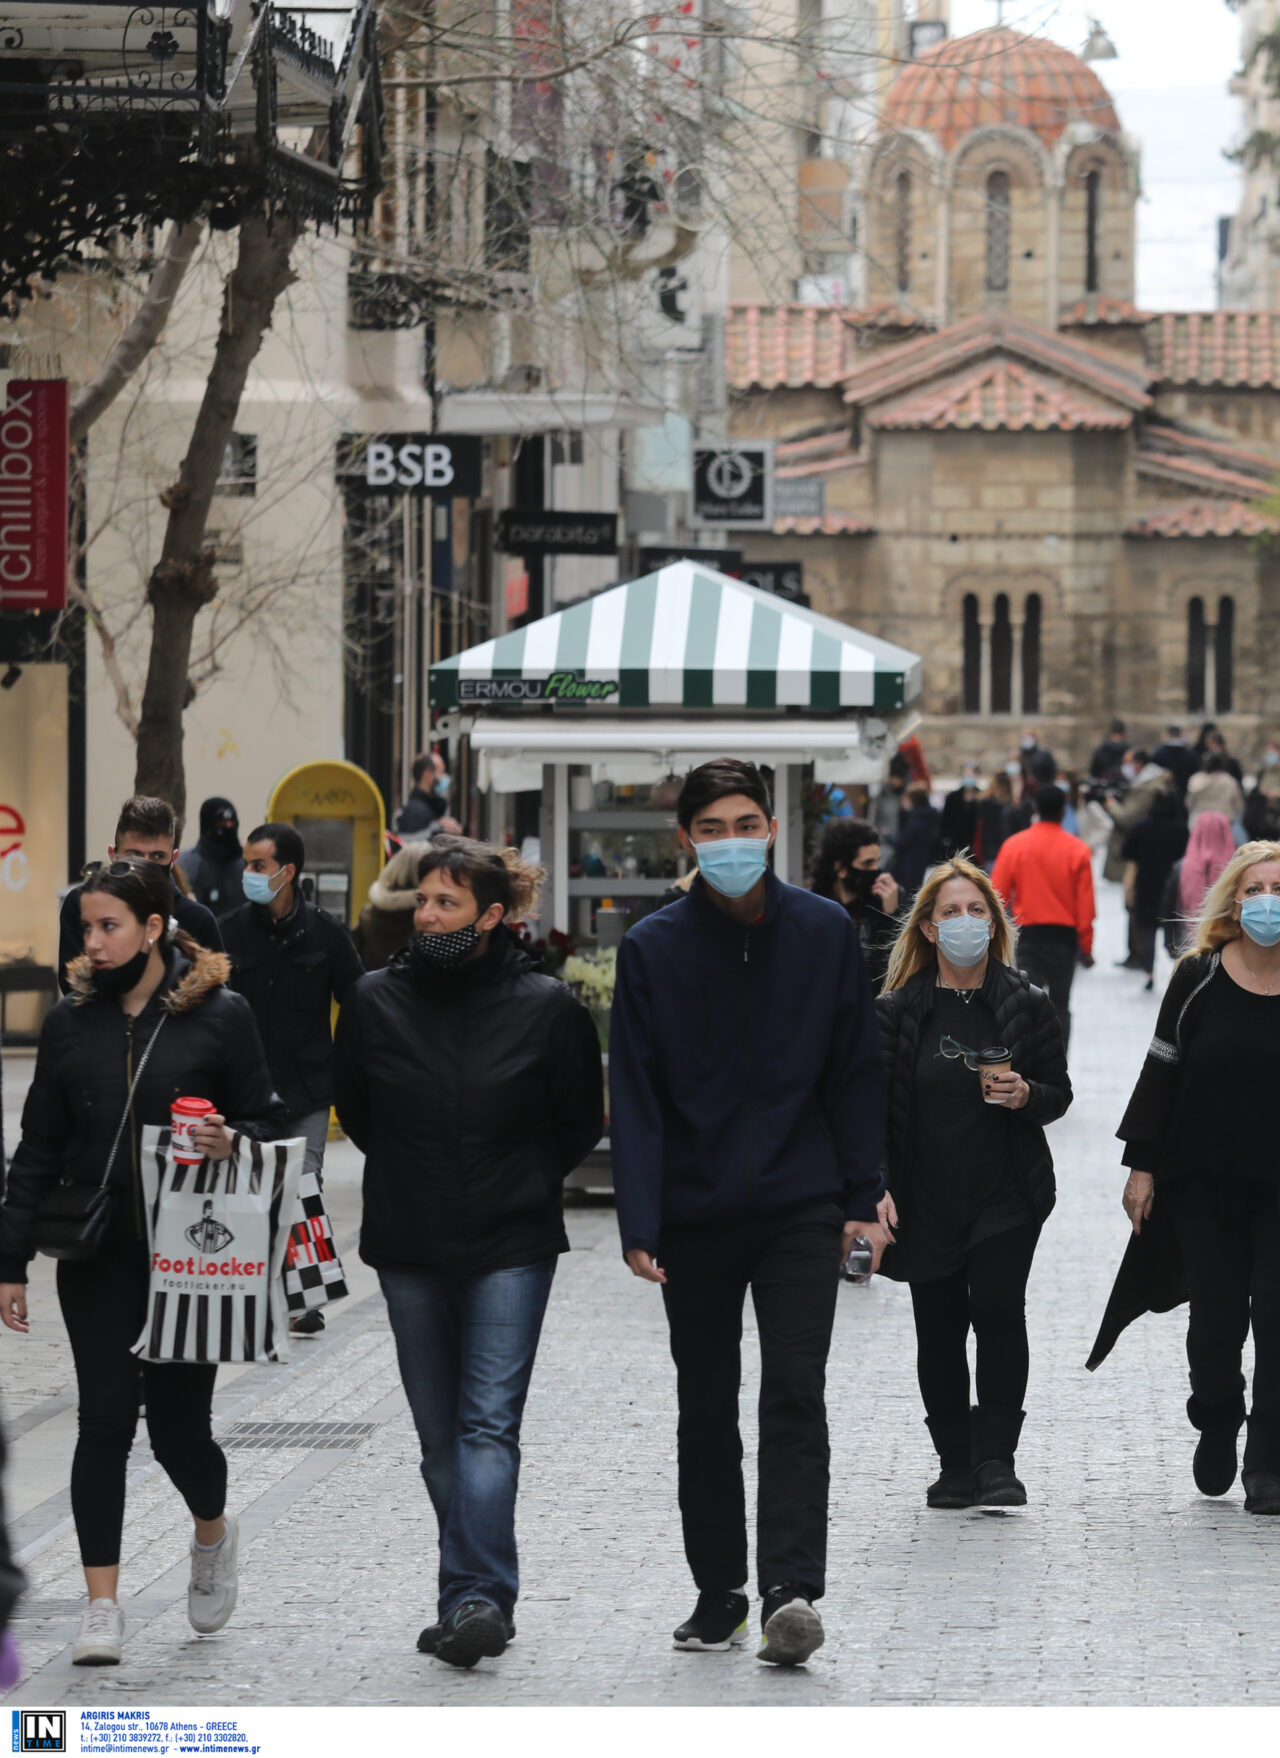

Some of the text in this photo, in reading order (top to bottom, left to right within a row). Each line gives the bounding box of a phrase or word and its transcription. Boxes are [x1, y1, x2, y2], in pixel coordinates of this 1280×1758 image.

[366, 443, 455, 487] BSB
[36, 491, 50, 535] yogurt
[459, 673, 618, 698] ERMOU Flower
[286, 1215, 334, 1268] AIR
[152, 1252, 267, 1277] Foot Locker
